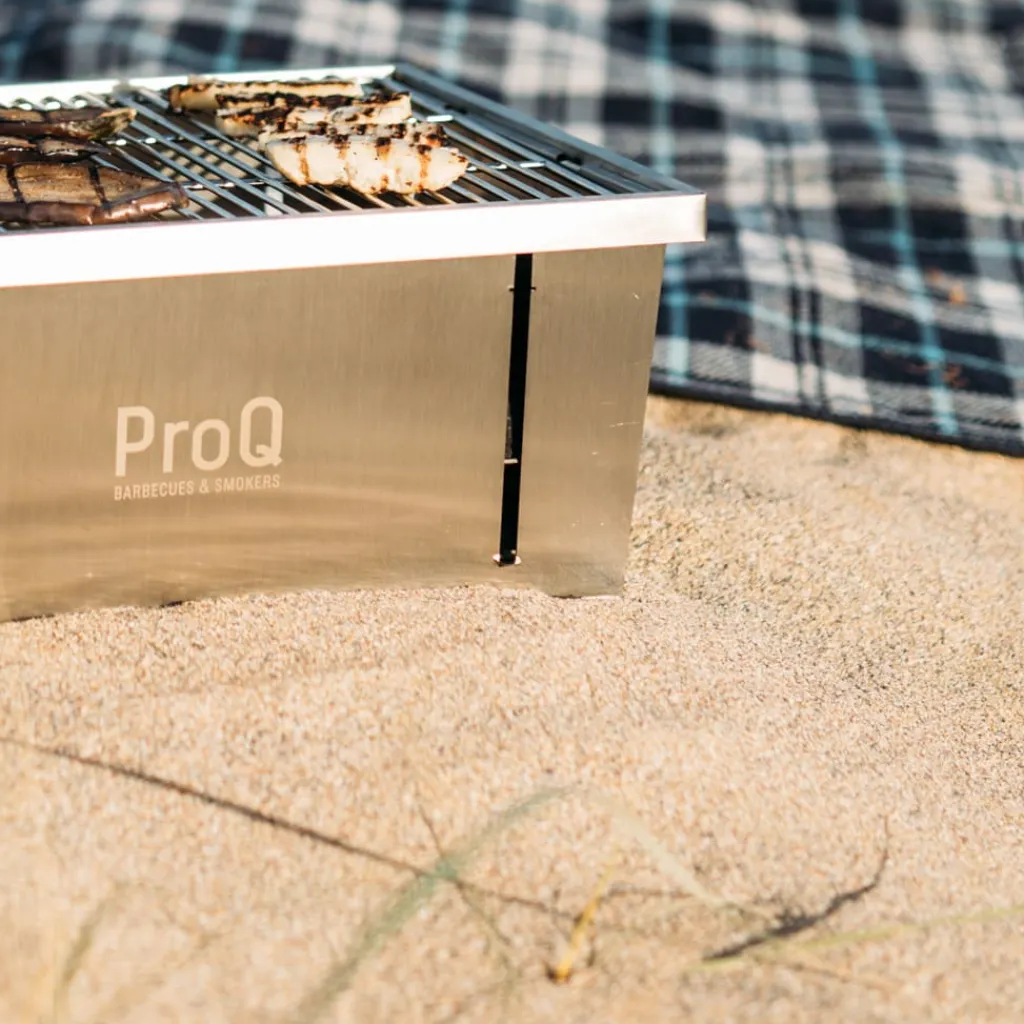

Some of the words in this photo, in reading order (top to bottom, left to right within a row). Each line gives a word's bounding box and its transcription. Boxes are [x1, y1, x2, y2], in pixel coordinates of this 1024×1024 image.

[115, 396, 283, 477] ProQ
[114, 480, 195, 501] BARBECUES
[198, 477, 210, 494] &
[214, 474, 281, 493] SMOKERS
